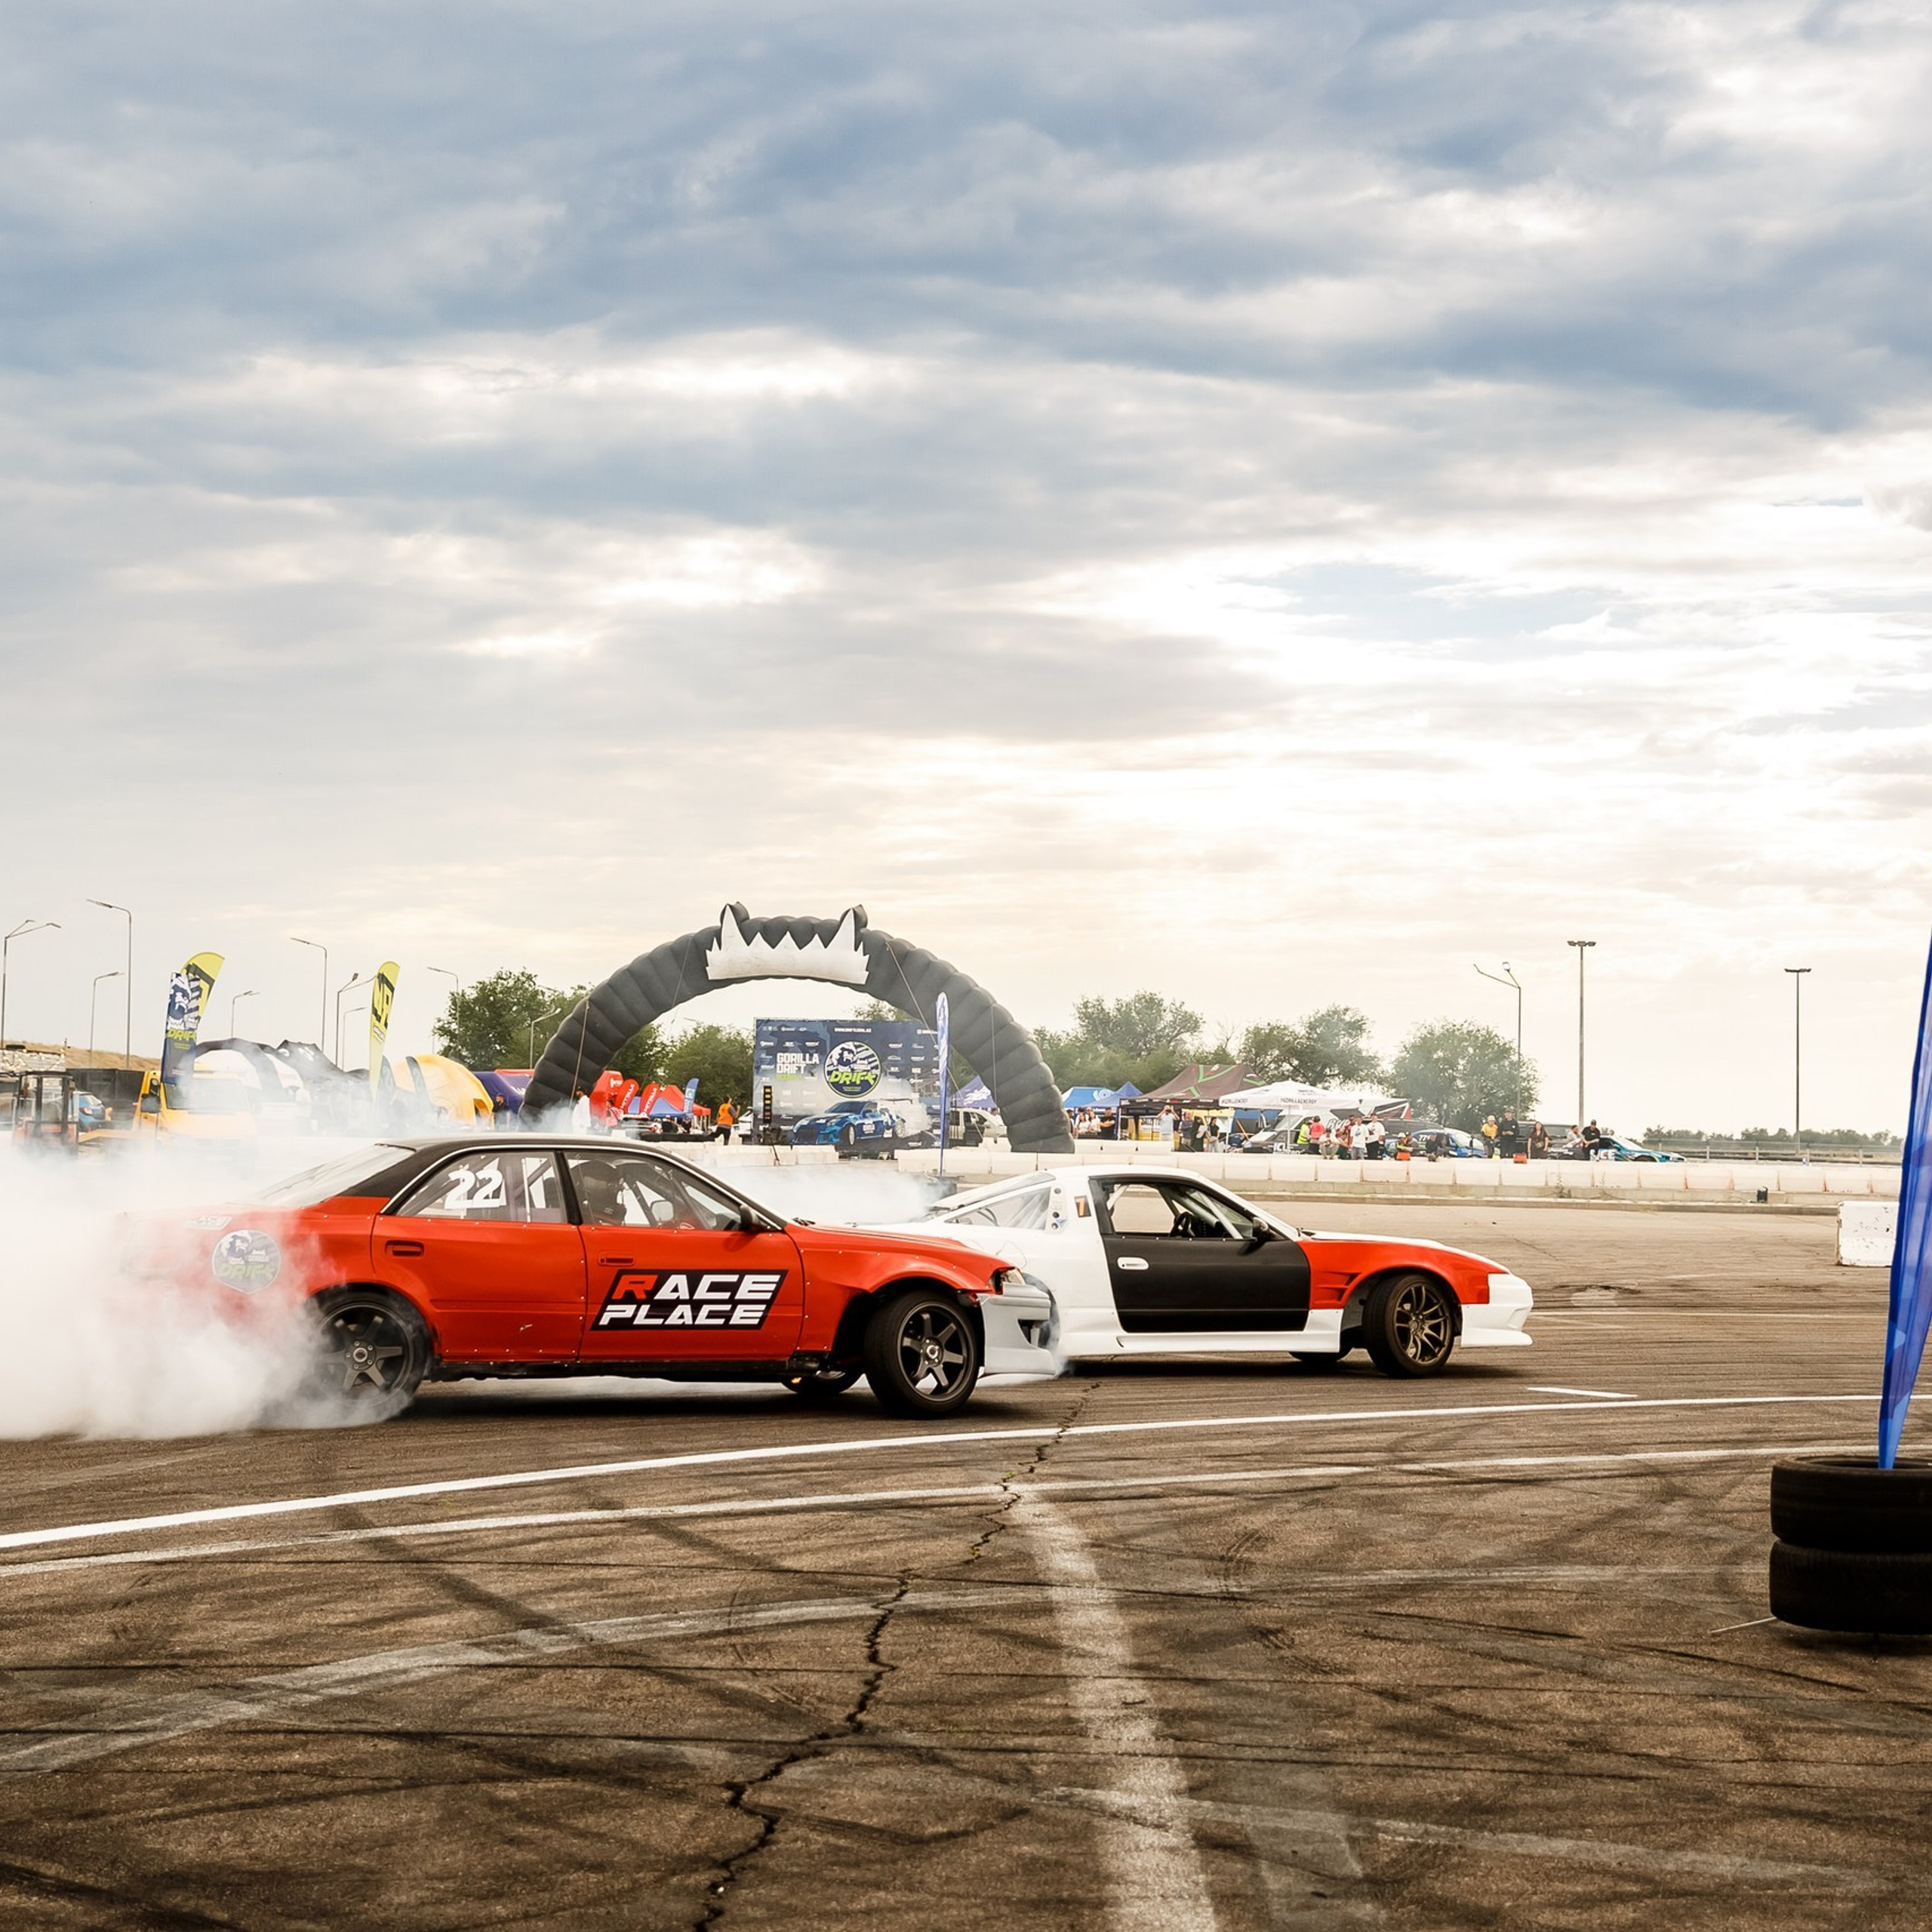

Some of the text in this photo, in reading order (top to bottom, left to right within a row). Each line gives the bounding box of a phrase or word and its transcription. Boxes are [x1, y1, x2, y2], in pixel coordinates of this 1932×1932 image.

[777, 1053, 820, 1064] GORILLA
[777, 1064, 806, 1074] DRIFT
[445, 1169, 503, 1209] 22
[611, 1275, 781, 1300] RACE
[598, 1304, 768, 1325] PLACE
